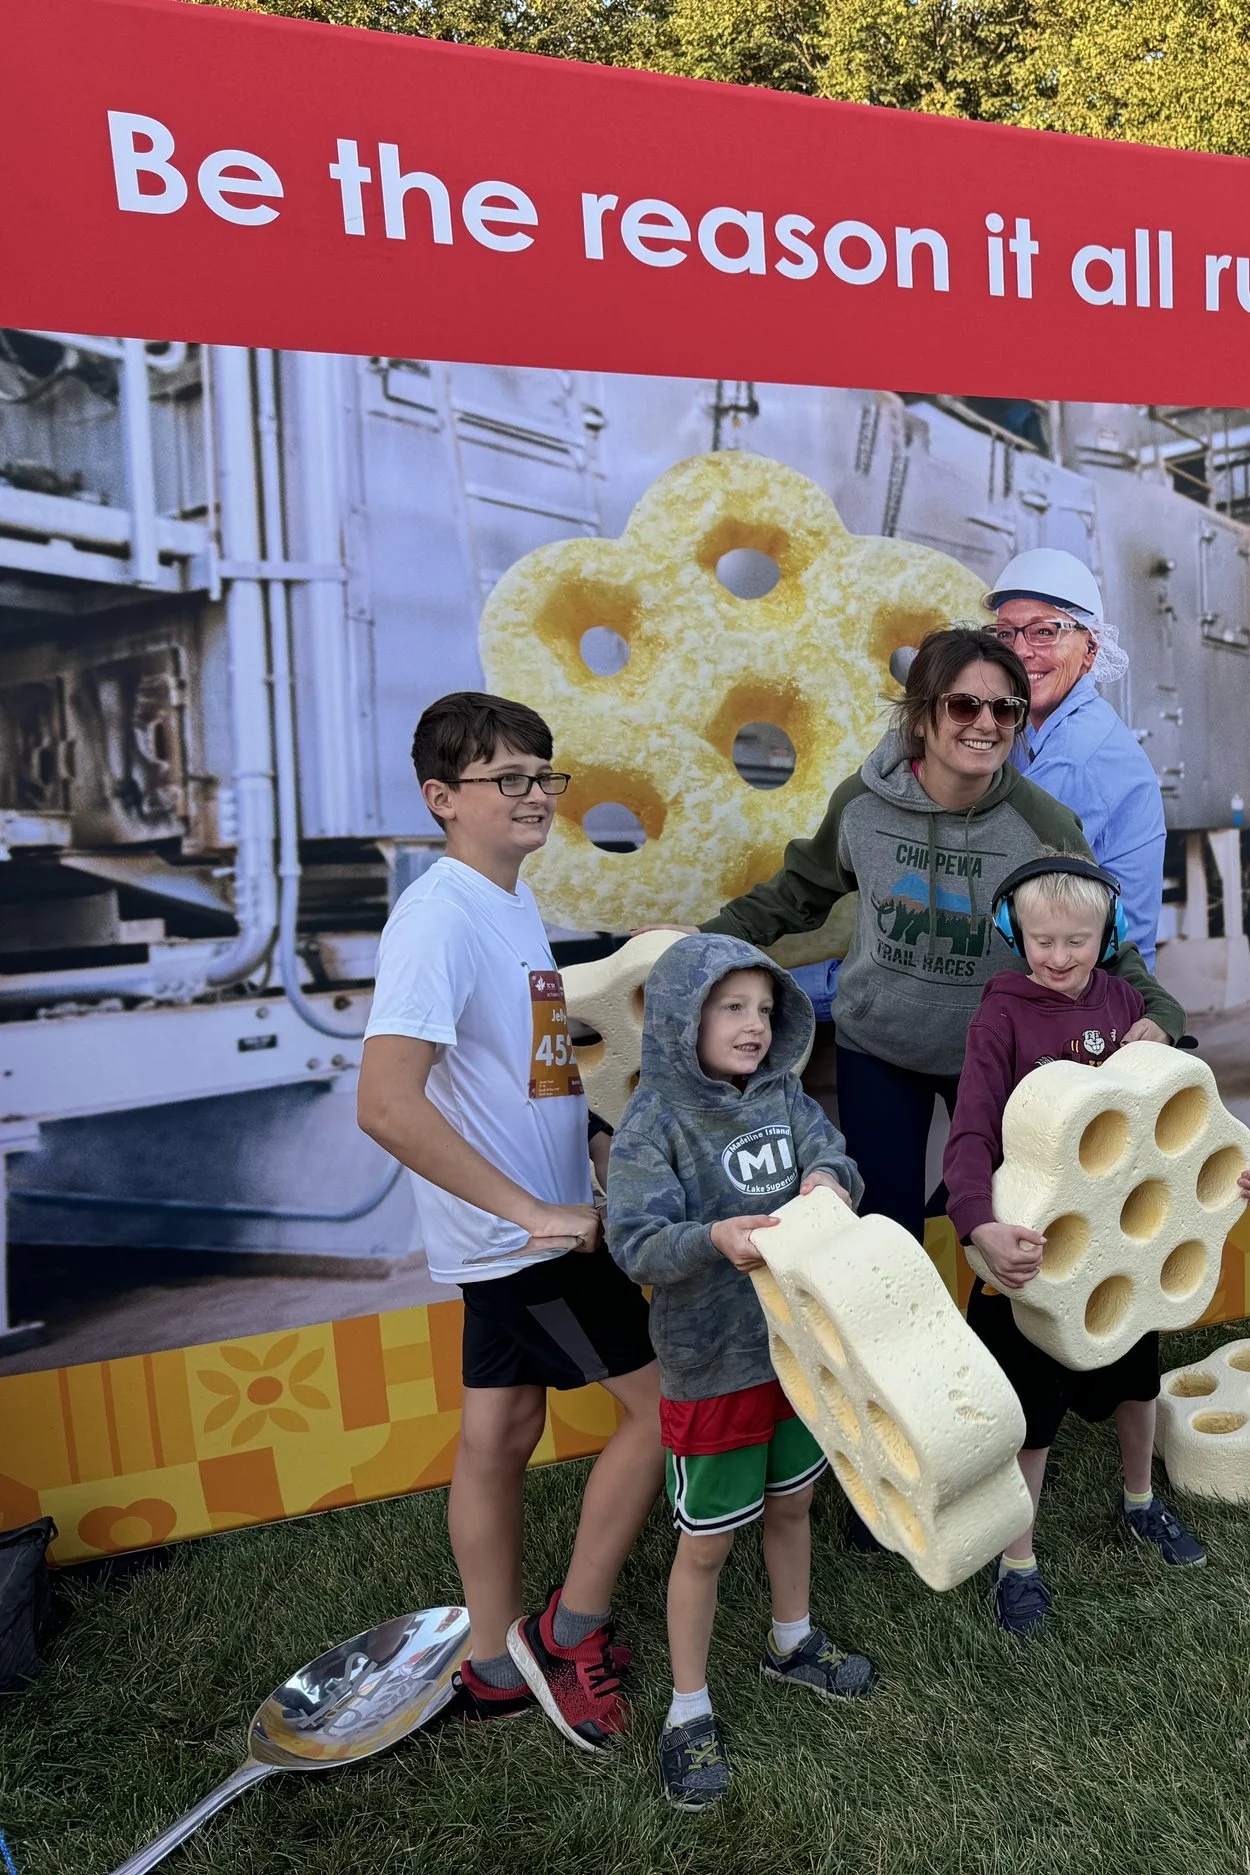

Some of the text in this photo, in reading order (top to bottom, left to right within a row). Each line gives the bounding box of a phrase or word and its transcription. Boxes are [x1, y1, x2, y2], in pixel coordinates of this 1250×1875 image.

[107, 110, 285, 227] Be
[329, 138, 539, 253] the
[582, 191, 951, 293] reason
[986, 212, 1039, 300] it
[1071, 228, 1174, 309] all
[877, 938, 976, 977] TRAIL RACES
[728, 1126, 790, 1153] Madeline Island
[736, 1137, 793, 1182] MI
[745, 1172, 797, 1193] Lake Superior
